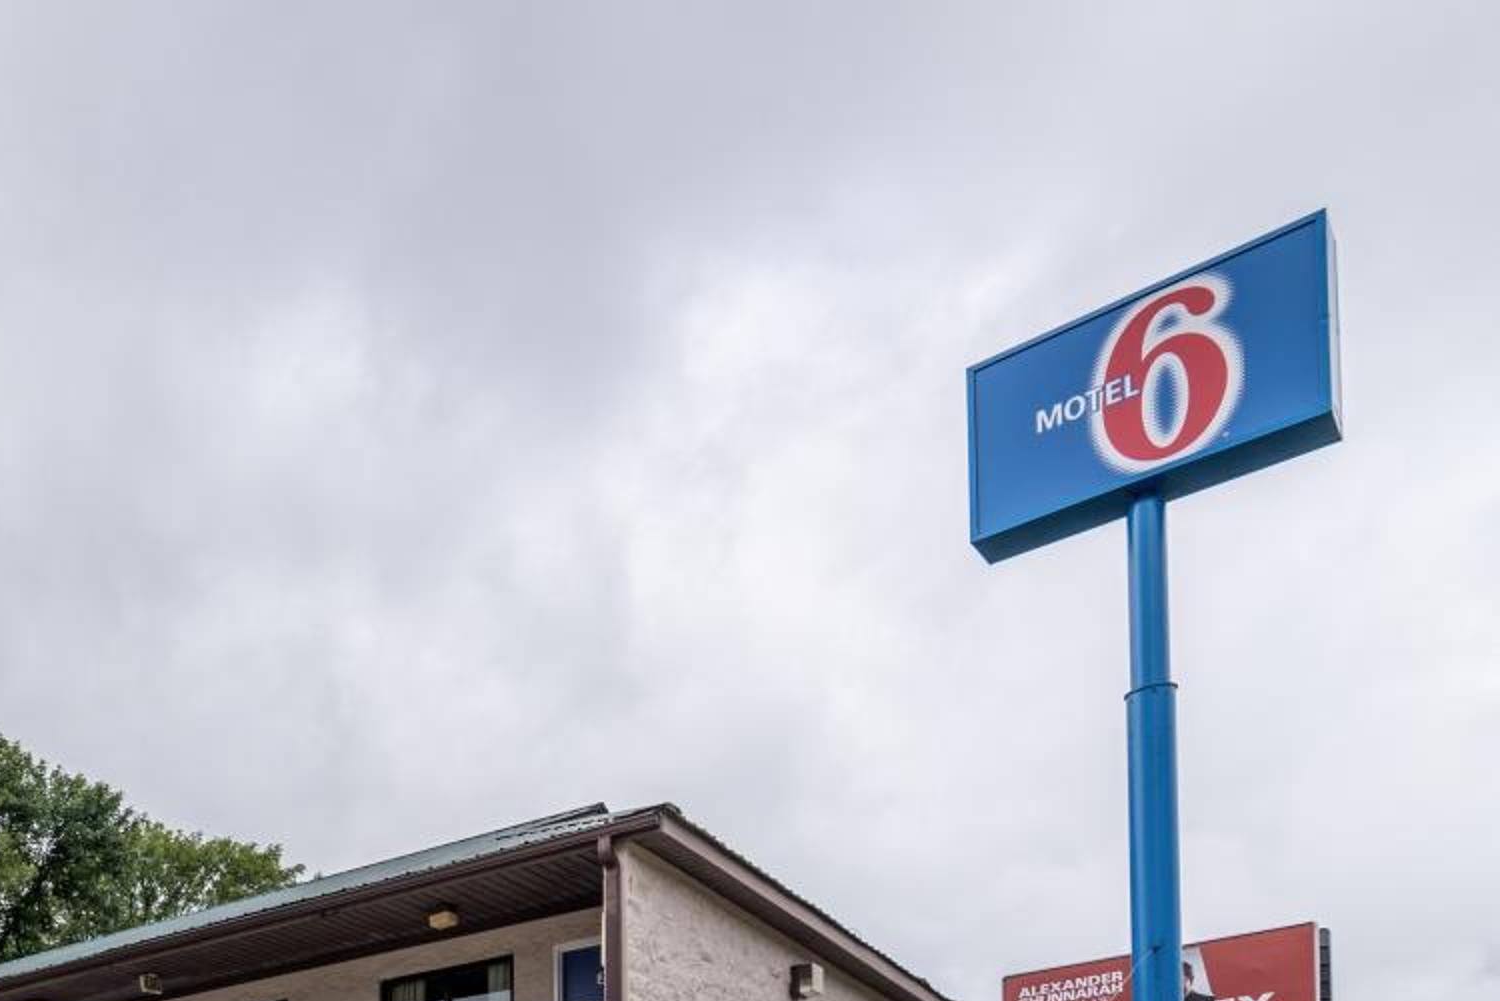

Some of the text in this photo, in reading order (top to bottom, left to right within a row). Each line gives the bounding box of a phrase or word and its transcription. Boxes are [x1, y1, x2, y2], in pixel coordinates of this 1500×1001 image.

[1034, 276, 1238, 468] MOTEL 6
[1018, 971, 1124, 998] ALEXANDER
